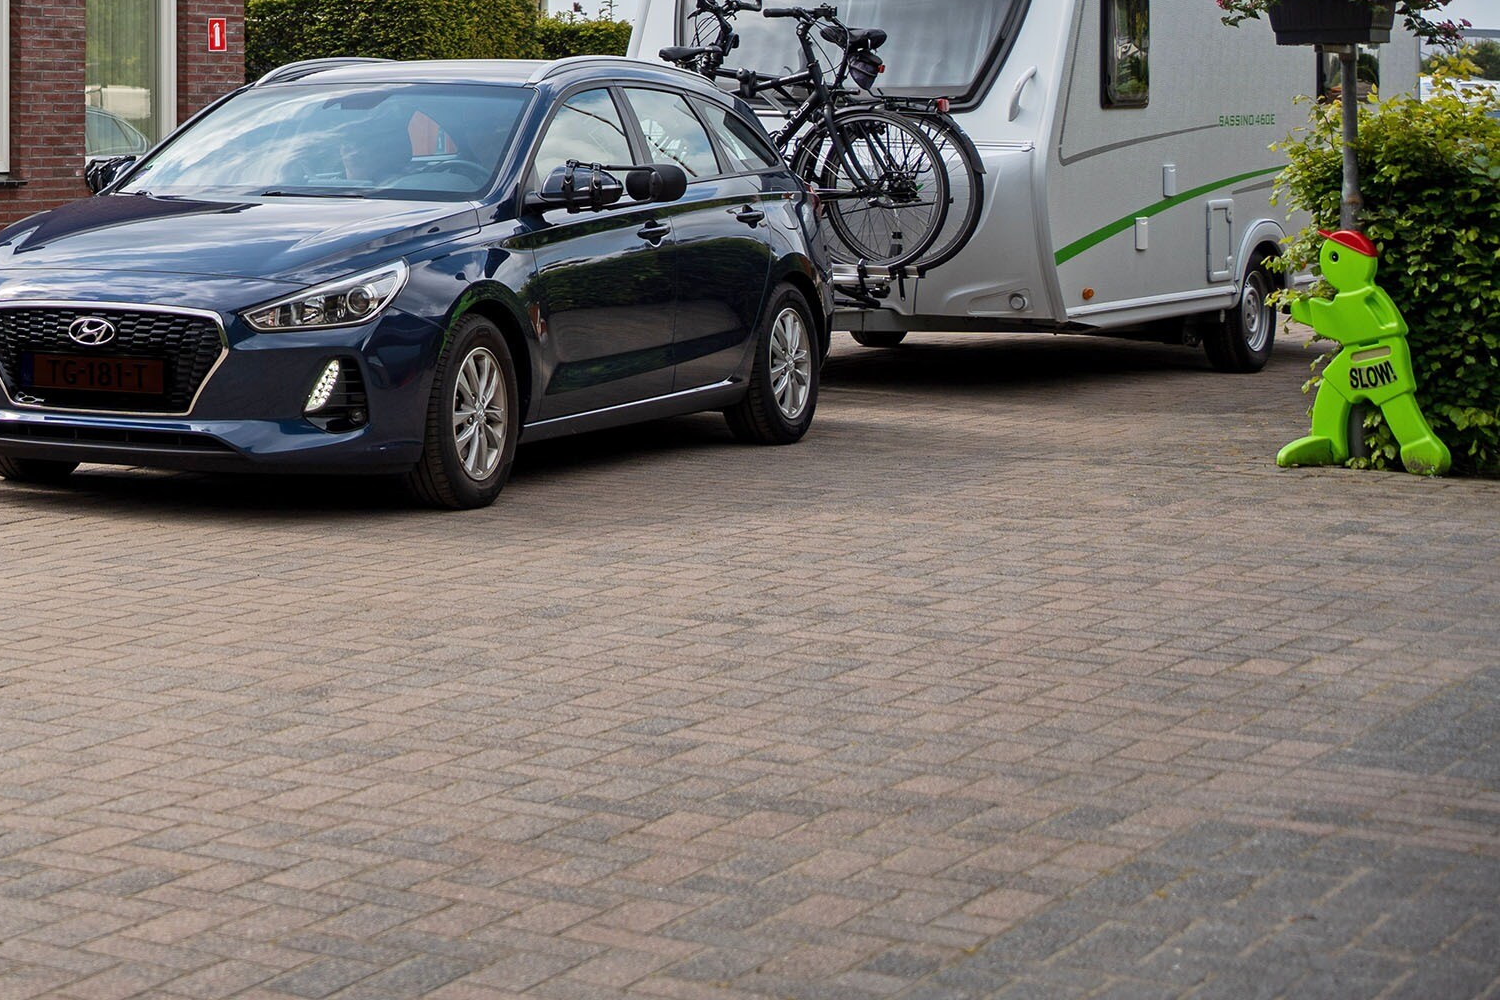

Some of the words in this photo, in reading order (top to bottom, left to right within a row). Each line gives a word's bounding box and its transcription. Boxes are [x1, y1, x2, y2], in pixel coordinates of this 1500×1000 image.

[774, 101, 810, 144] ANTOS
[1219, 114, 1255, 127] SASSINO
[1255, 113, 1276, 126] 460E
[47, 359, 148, 389] TG-181-T
[1350, 360, 1398, 389] SLOW!
